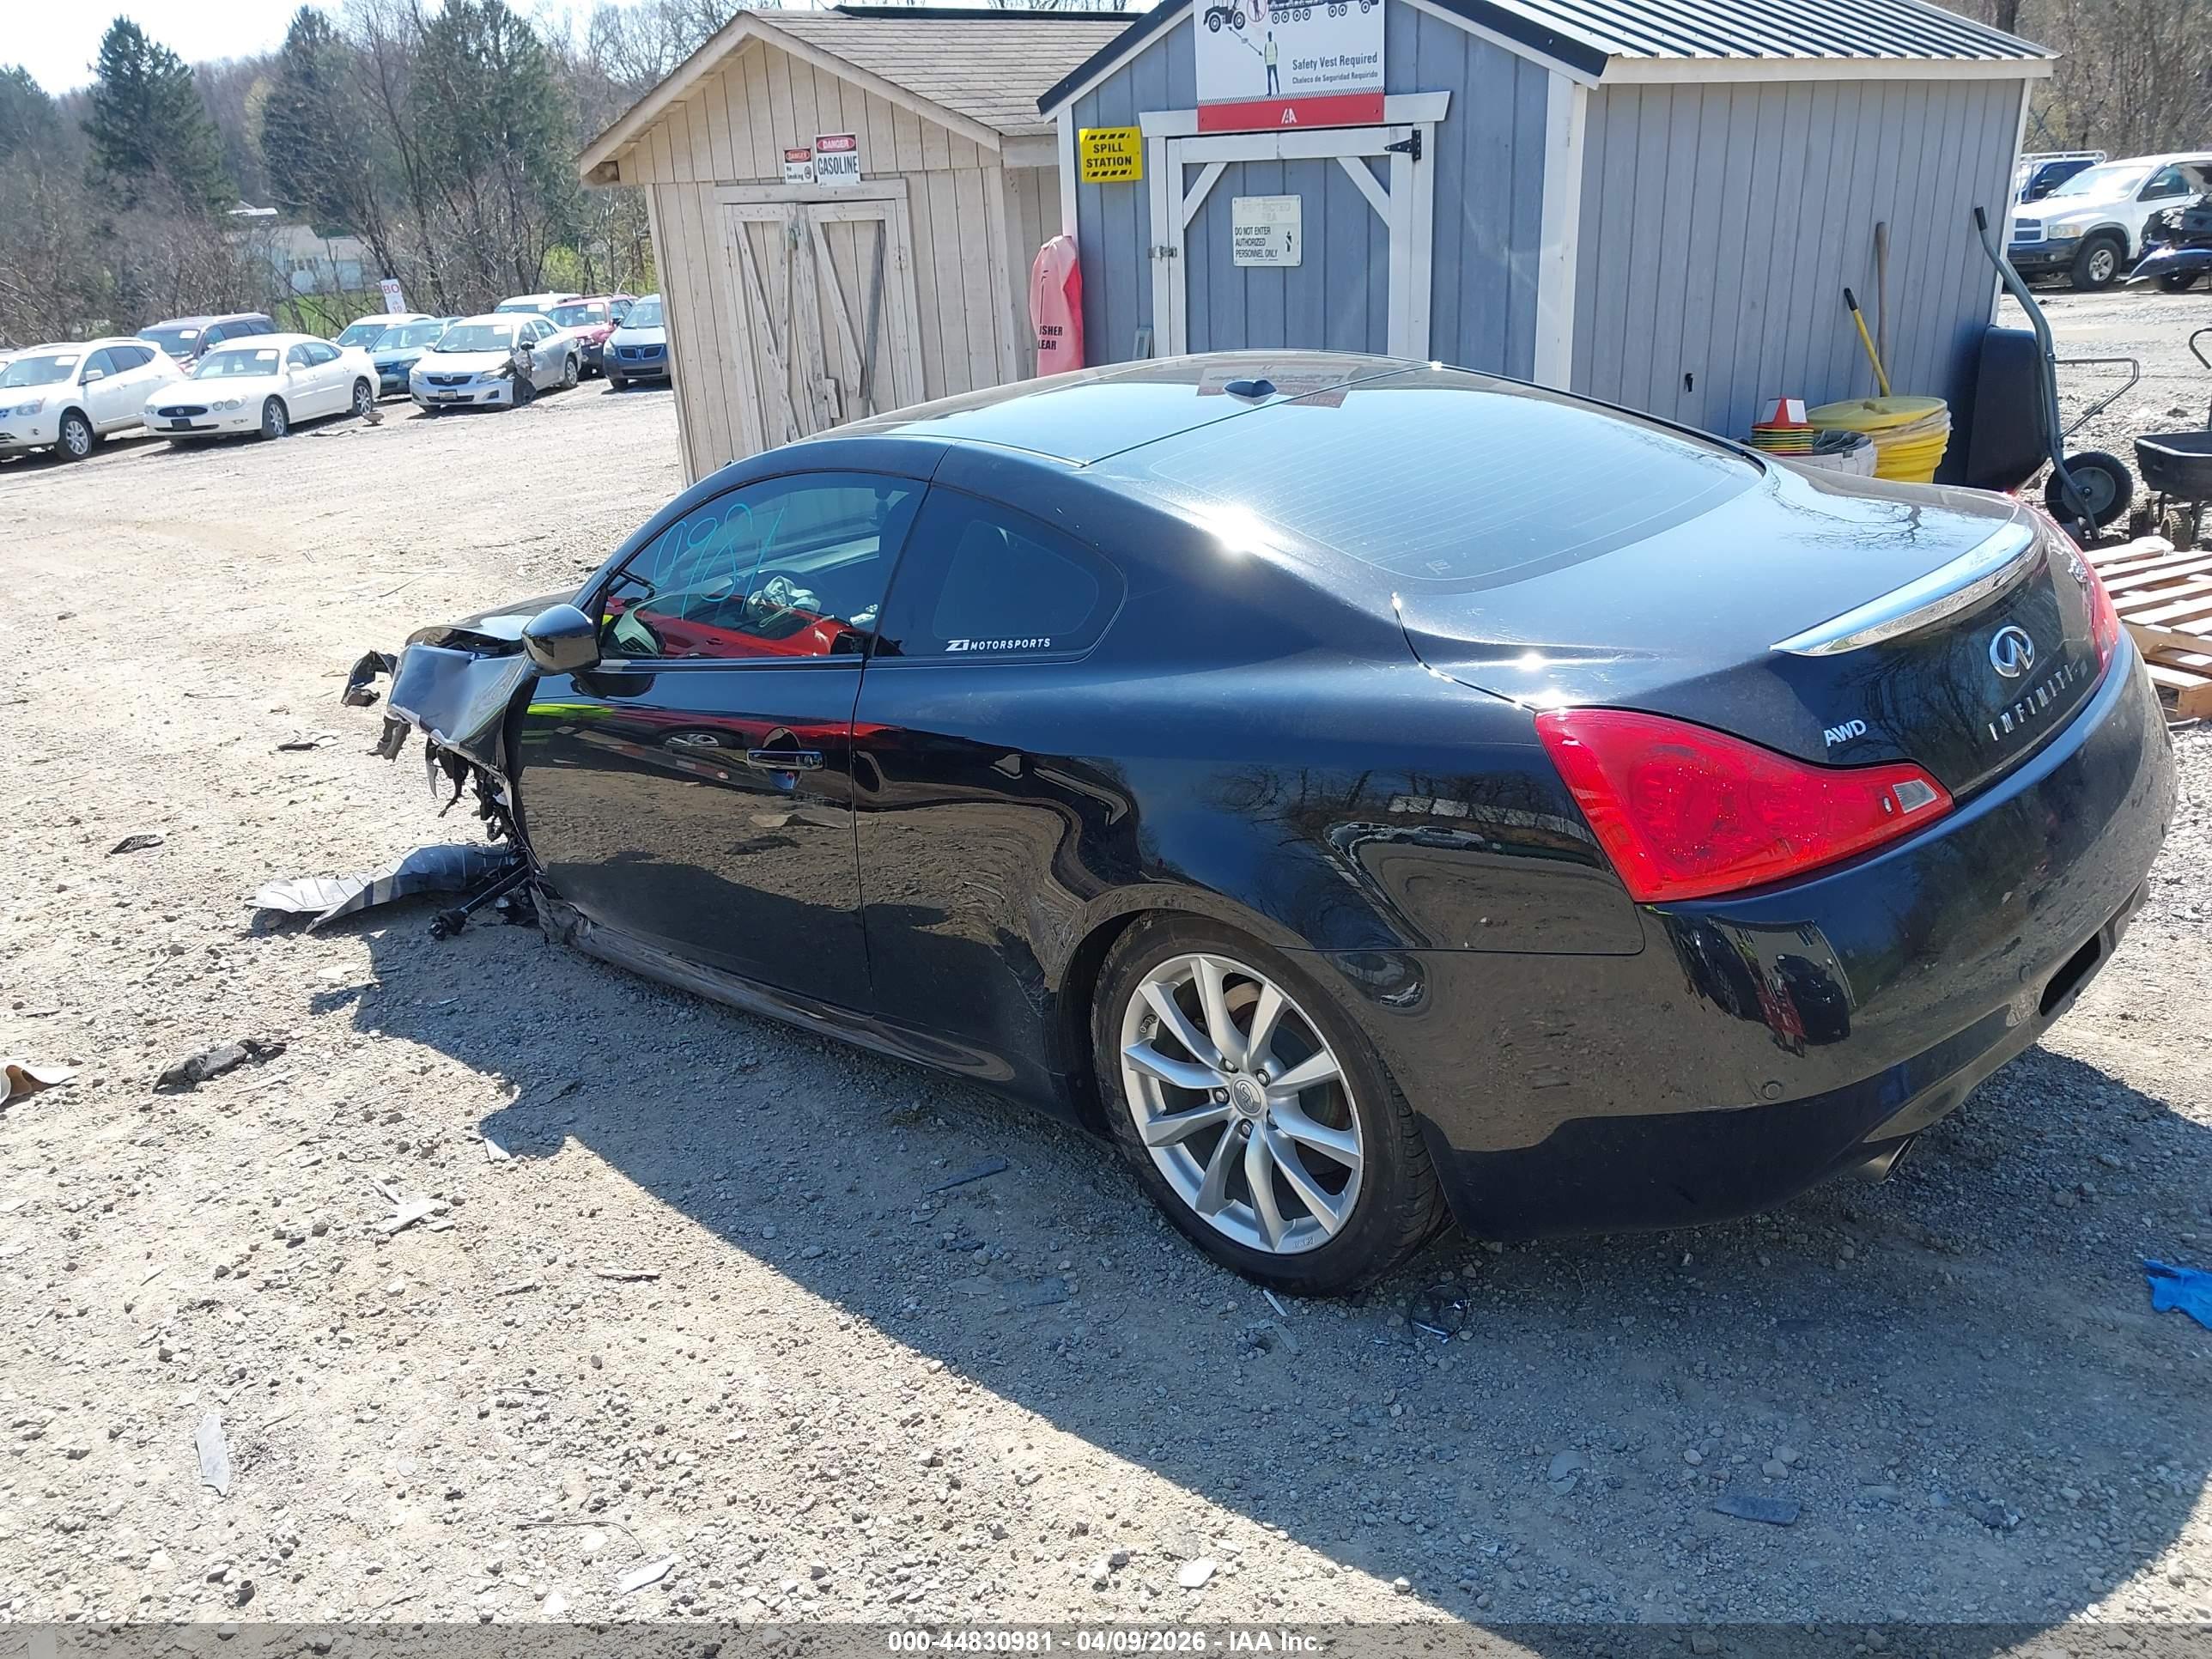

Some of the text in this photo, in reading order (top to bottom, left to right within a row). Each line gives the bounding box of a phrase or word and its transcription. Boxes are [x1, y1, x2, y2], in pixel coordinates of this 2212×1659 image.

[1292, 52, 1377, 71] Safety Vest Required
[1292, 76, 1314, 84] Chaleco
[1322, 72, 1350, 82] Seguridad
[823, 139, 849, 149] DANGER
[1093, 143, 1124, 154] SPILL
[817, 155, 859, 175] GASOLINE
[1086, 155, 1132, 168] STATION
[1235, 226, 1271, 235] DO NOT ENTER
[1236, 238, 1266, 246] AUTHORIZED
[970, 638, 1051, 651] MOTORSPORTS
[1989, 665, 2075, 741] INFINITI
[1823, 719, 1867, 747] AWD
